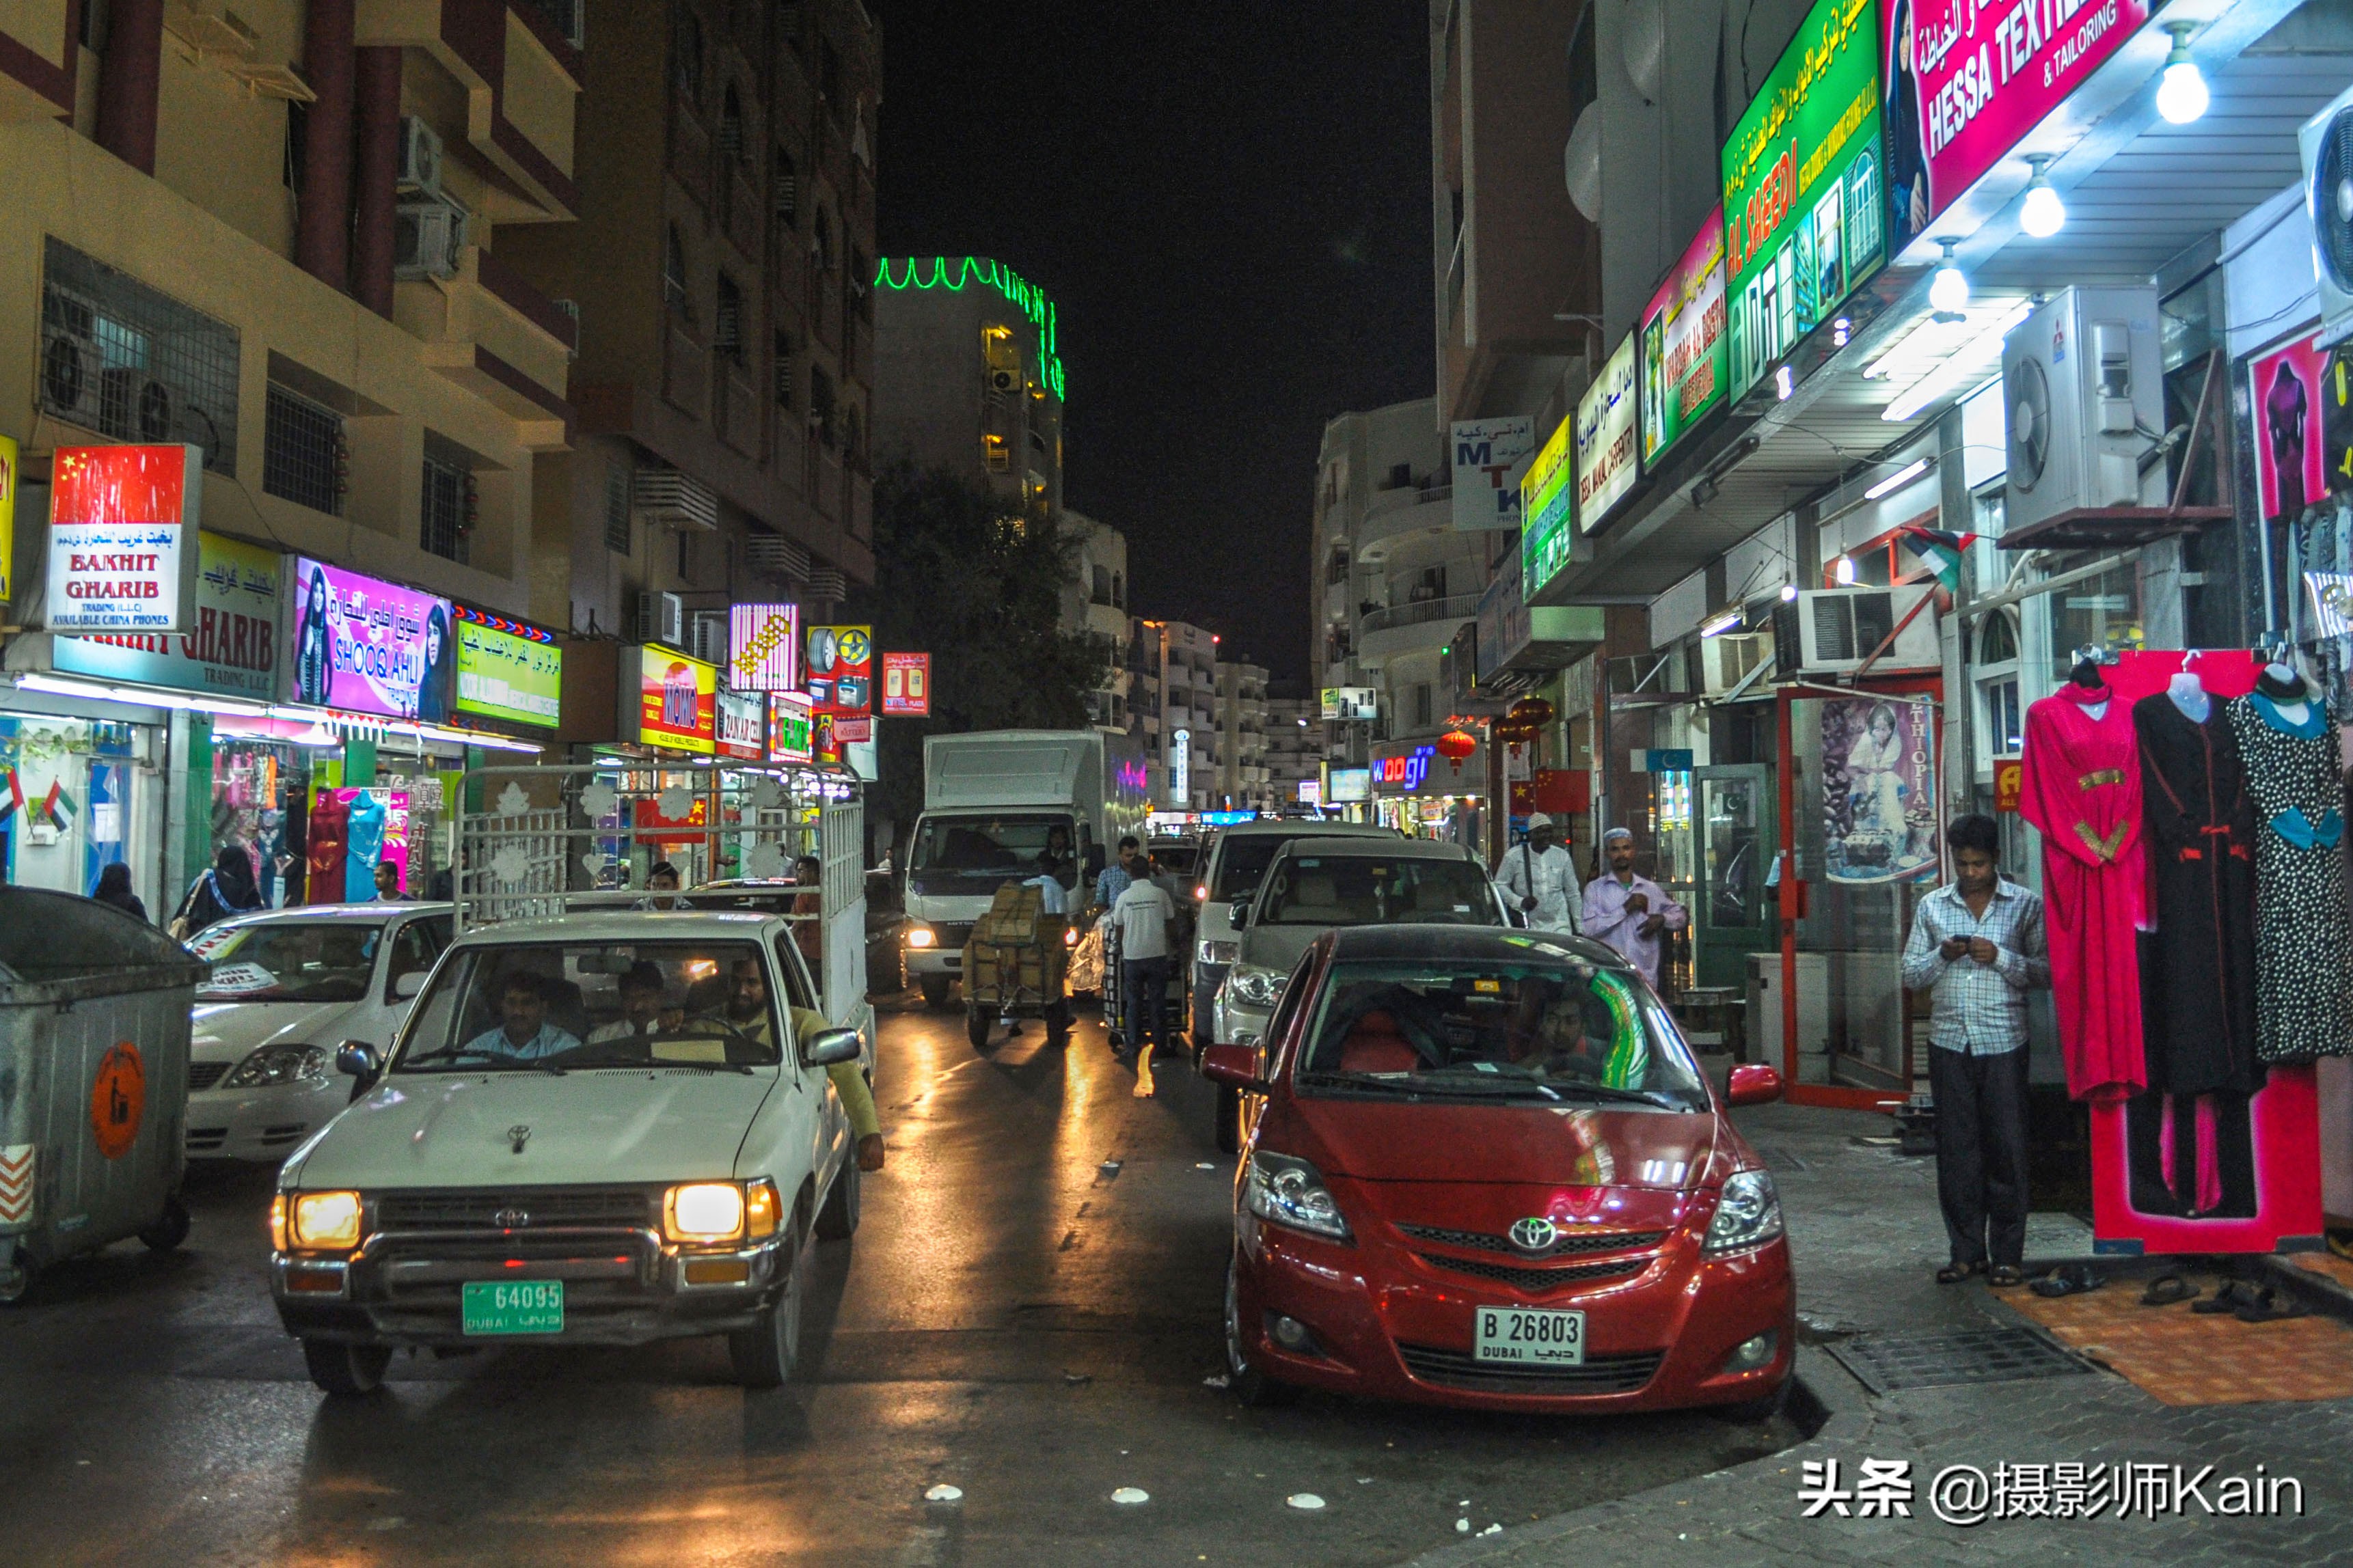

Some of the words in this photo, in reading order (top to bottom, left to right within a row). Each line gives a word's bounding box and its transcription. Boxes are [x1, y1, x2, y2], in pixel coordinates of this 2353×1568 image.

[2043, 61, 2052, 88] &
[2053, 0, 2117, 77] TAILORING
[1928, 42, 1993, 159] HESSA
[1995, 0, 2089, 86] TEXTI
[1726, 216, 1743, 286] AL
[1745, 137, 1797, 264] SAEEDI
[1457, 442, 1491, 466] M
[1481, 465, 1512, 489] T
[1498, 489, 1522, 512] K
[70, 553, 160, 572] BAKHIT
[66, 581, 159, 599] GHARIB
[81, 603, 115, 611] TRADING
[52, 615, 100, 625] AVAILABLE
[102, 615, 130, 624] CHINA
[132, 615, 169, 624] PHONES
[334, 637, 387, 679] SHOOQ
[390, 648, 419, 684] AHLI
[204, 667, 245, 689] TRADING
[664, 681, 698, 730] MOMO
[1910, 696, 1927, 805] ETHIOPIA
[1373, 756, 1428, 790] woogi
[495, 1286, 559, 1310] 64095
[467, 1318, 508, 1330] DUBAI
[1484, 1313, 1497, 1338] B
[1509, 1313, 1579, 1343] 26803
[1482, 1346, 1523, 1359] DUBAI
[1534, 1349, 1575, 1361] دبي
